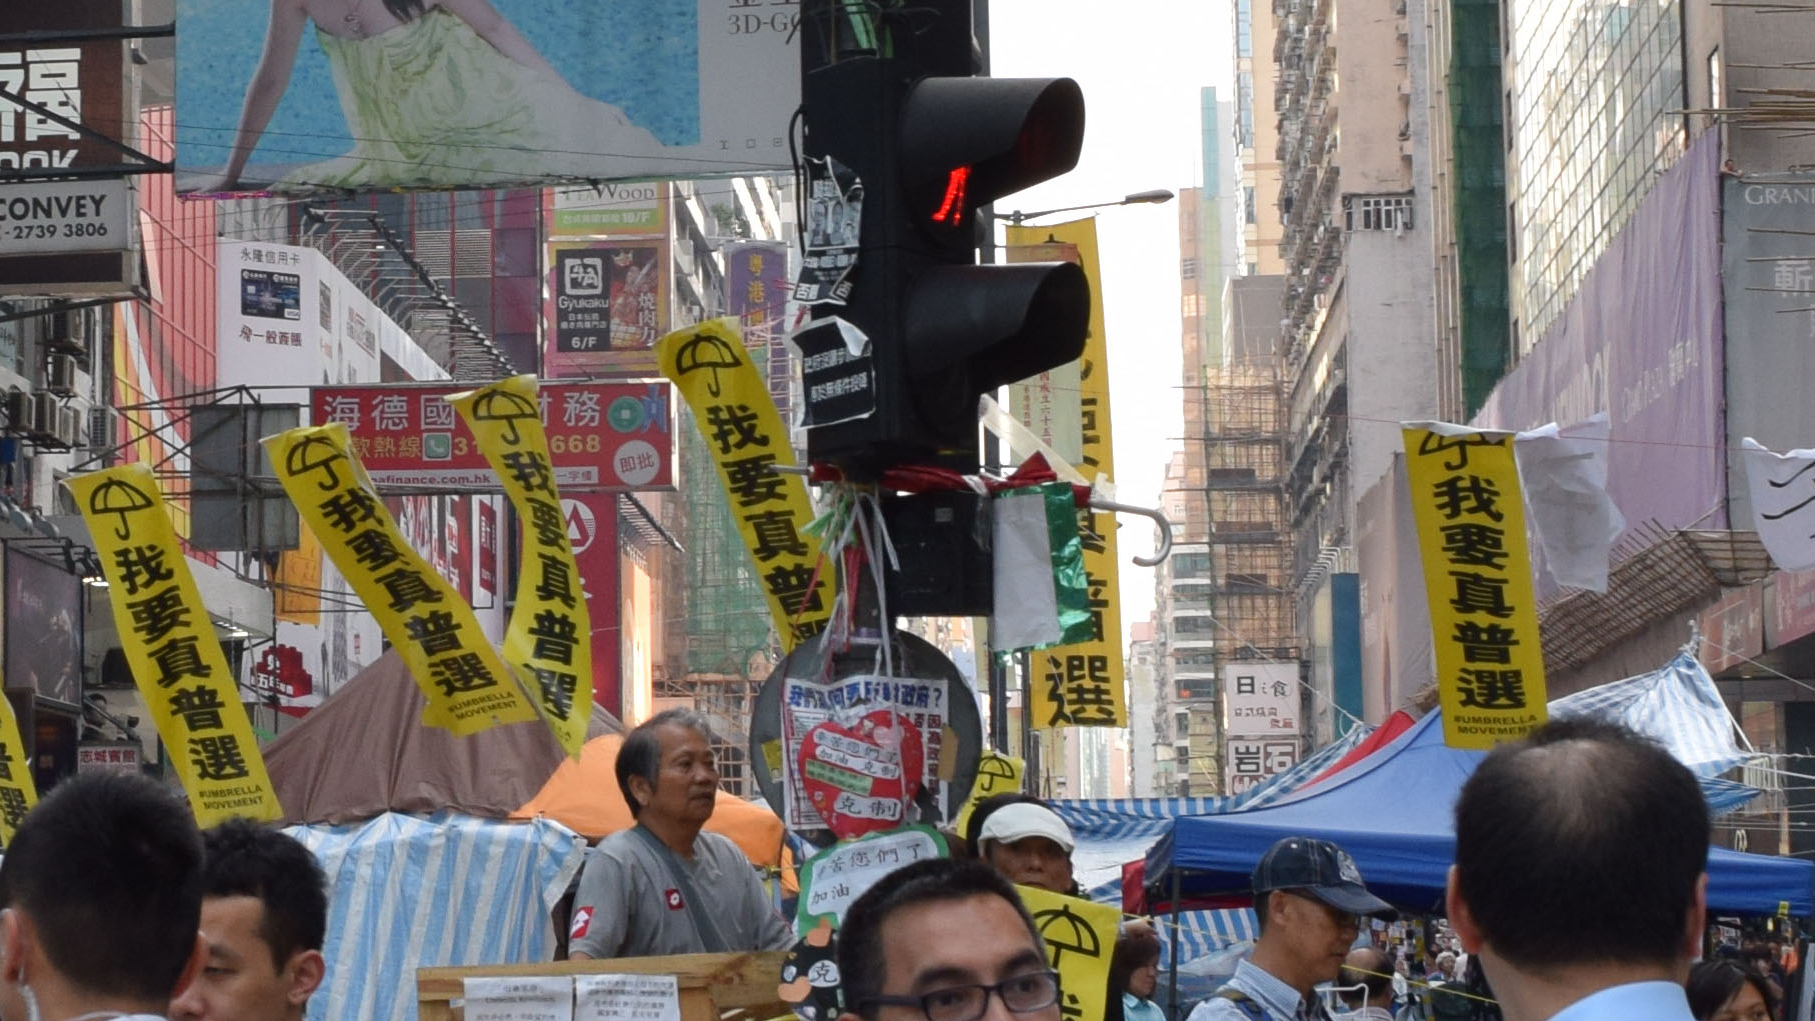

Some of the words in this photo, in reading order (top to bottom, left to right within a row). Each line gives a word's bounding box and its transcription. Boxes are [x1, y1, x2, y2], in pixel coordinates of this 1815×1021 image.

[1745, 184, 1815, 205] GRAN
[13, 225, 57, 240] 2739
[64, 223, 107, 238] 3806
[558, 295, 610, 312] Gyukaku
[571, 336, 598, 350] 6/F
[371, 473, 492, 486] afinance.com.hk
[316, 486, 498, 698] 我要真普選
[501, 451, 581, 722] 我要真普選
[1432, 475, 1527, 710] 我要真普選
[113, 543, 249, 781] 我要真普選
[448, 691, 515, 714] #UMBRELLA
[454, 700, 517, 721] MOVEMENT
[198, 784, 263, 799] #UMBRELLA
[203, 795, 264, 810] MOVEMENT
[838, 795, 899, 818] 克制
[812, 883, 851, 906] 加油
